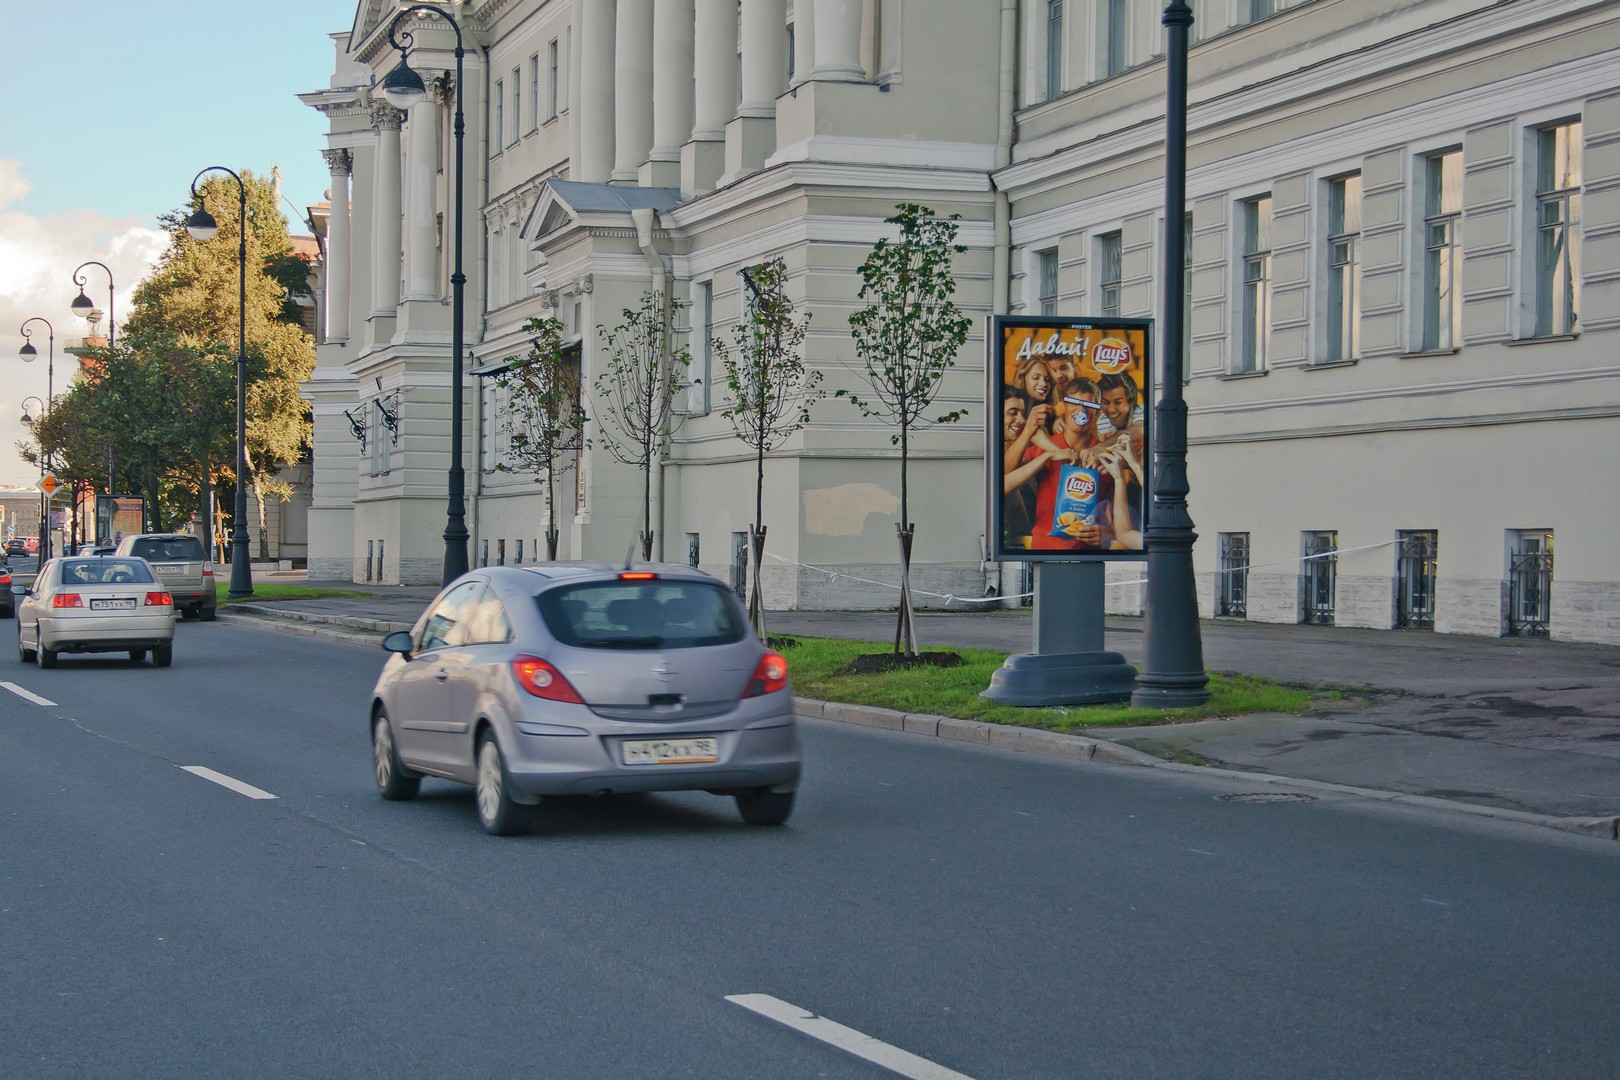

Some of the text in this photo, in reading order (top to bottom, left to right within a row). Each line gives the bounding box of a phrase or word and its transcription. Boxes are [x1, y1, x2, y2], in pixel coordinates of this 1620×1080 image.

[1016, 333, 1090, 361] Давай!
[1094, 343, 1128, 368] Lay's
[1067, 477, 1094, 496] Lay's
